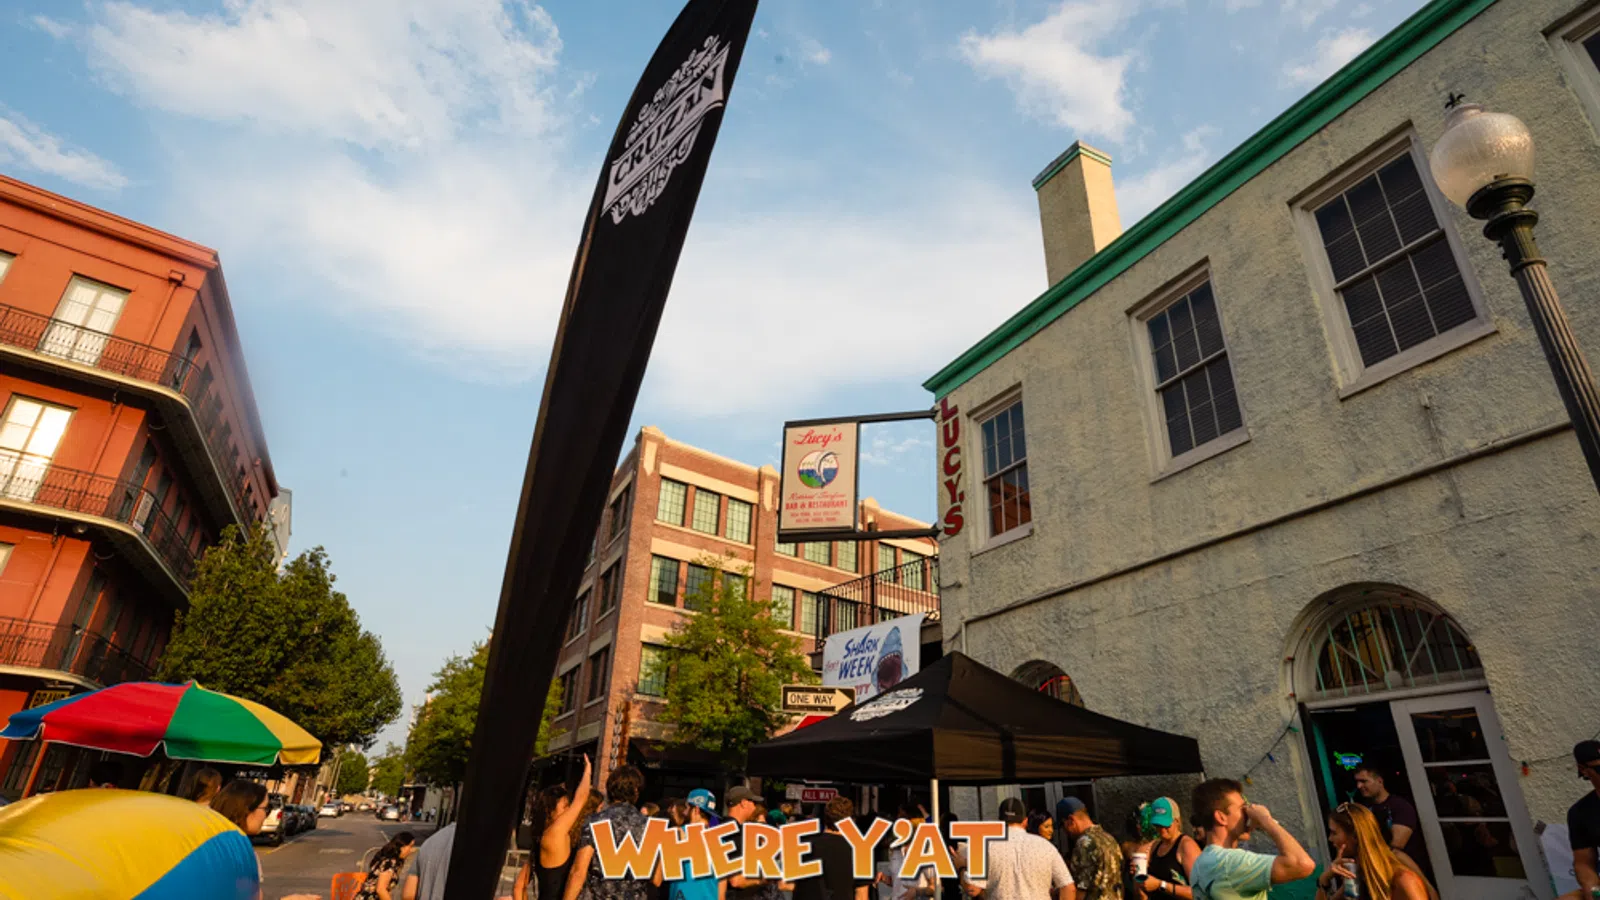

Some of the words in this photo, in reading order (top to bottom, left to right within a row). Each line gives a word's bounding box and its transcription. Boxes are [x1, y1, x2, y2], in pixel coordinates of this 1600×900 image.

[613, 63, 717, 186] CRUZAN
[793, 428, 843, 448] Lucy's
[940, 396, 965, 536] LUCY'S
[785, 502, 798, 510] BAR
[808, 500, 848, 509] RESTAURANT
[843, 631, 880, 659] SHARK
[838, 656, 876, 681] WEEK
[789, 694, 811, 705] ONE
[813, 694, 834, 705] WAY
[803, 791, 817, 800] ALL
[819, 791, 835, 800] WAY
